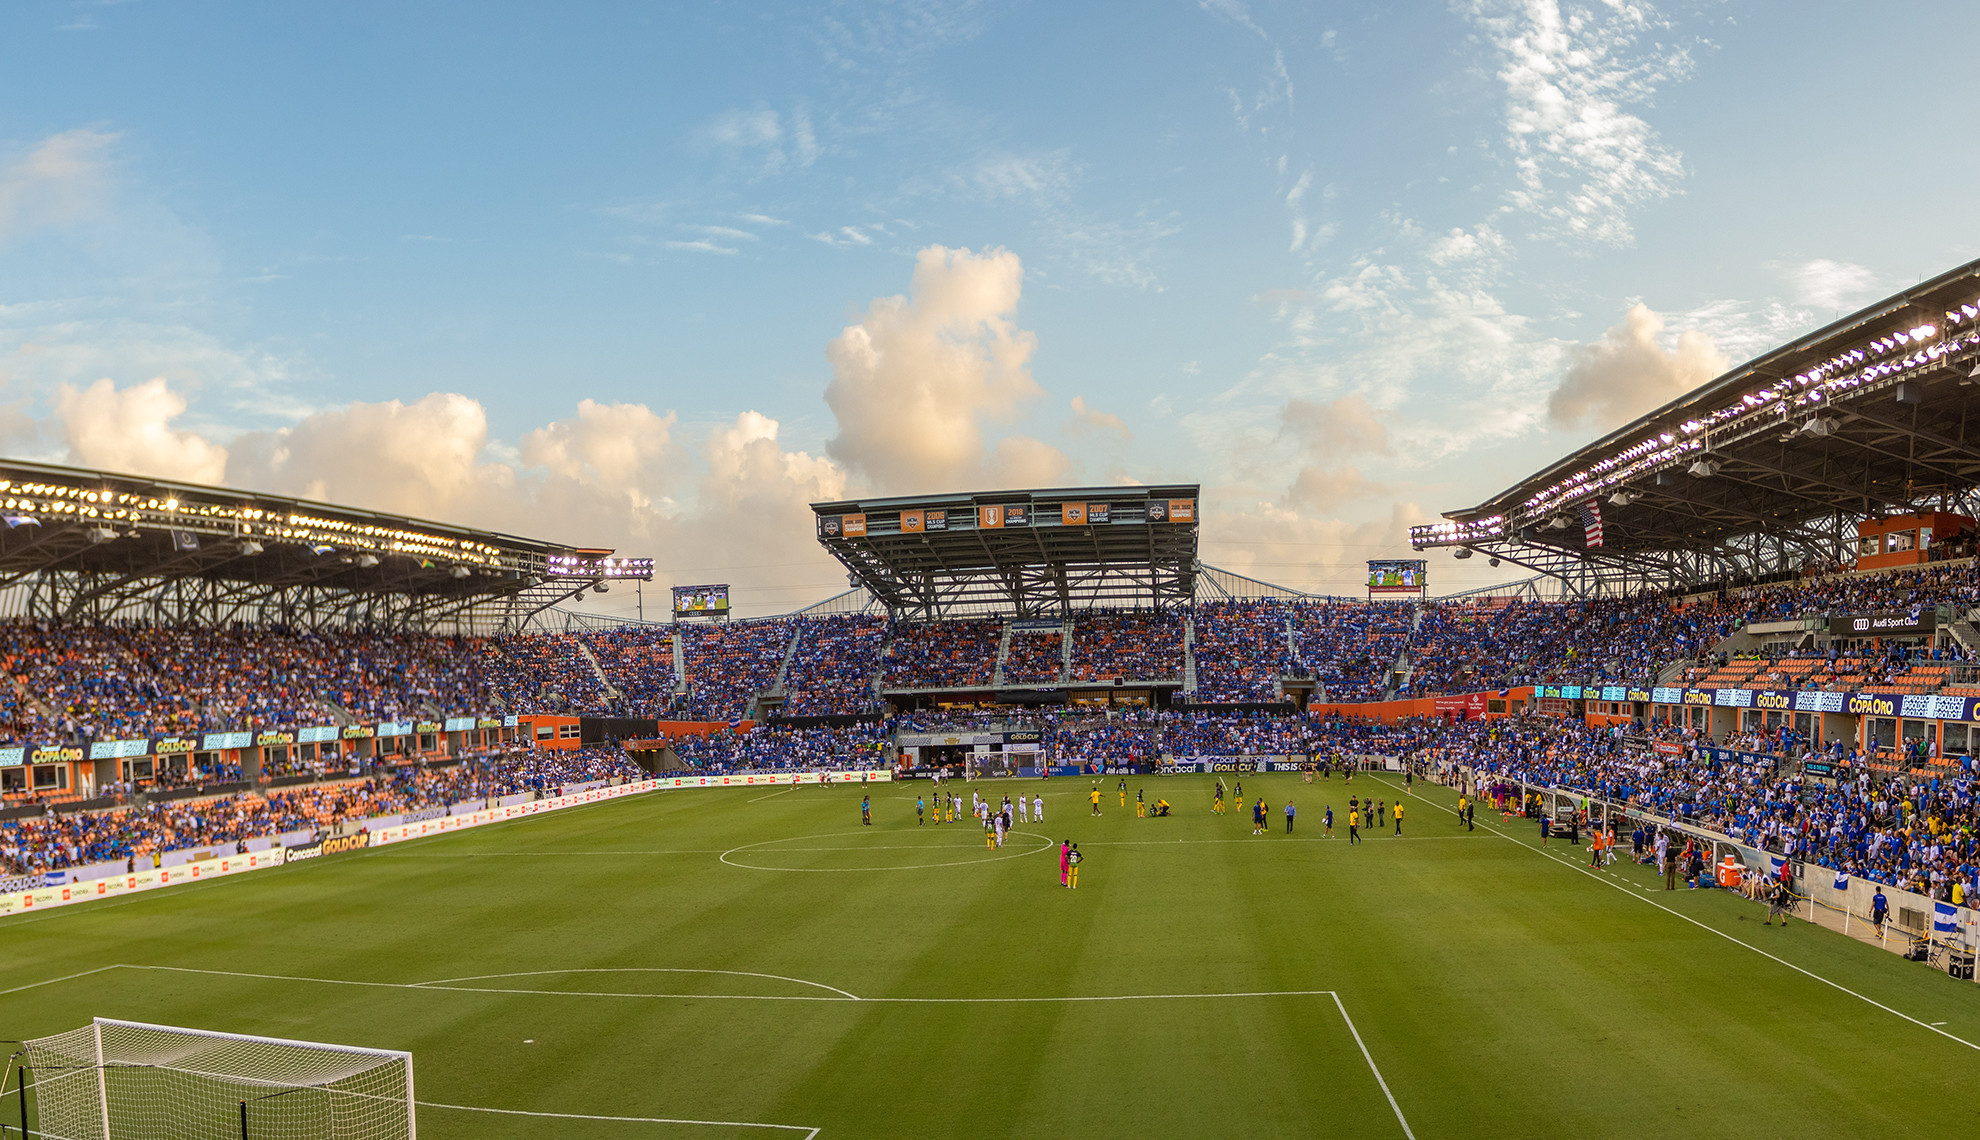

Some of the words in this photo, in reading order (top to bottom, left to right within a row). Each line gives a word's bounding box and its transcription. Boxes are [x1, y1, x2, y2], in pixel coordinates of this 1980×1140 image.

[1872, 619, 1887, 628] Audi
[1888, 618, 1904, 628] Sport
[1757, 694, 1775, 708] GOLD
[1776, 695, 1790, 709] CUP
[1849, 697, 1873, 714] COPA
[1873, 698, 1894, 716] ORO
[156, 741, 180, 753] GOLD
[180, 739, 197, 752] CUP
[31, 749, 60, 764] COPA
[60, 748, 84, 761] ORO
[992, 769, 1006, 778] Sprint
[1155, 764, 1196, 774] oncacaf
[1274, 763, 1290, 771] THIS
[286, 843, 322, 862] Concacaf
[322, 839, 349, 856] GOLD
[349, 834, 368, 849] CUP
[1720, 869, 1726, 884] G
